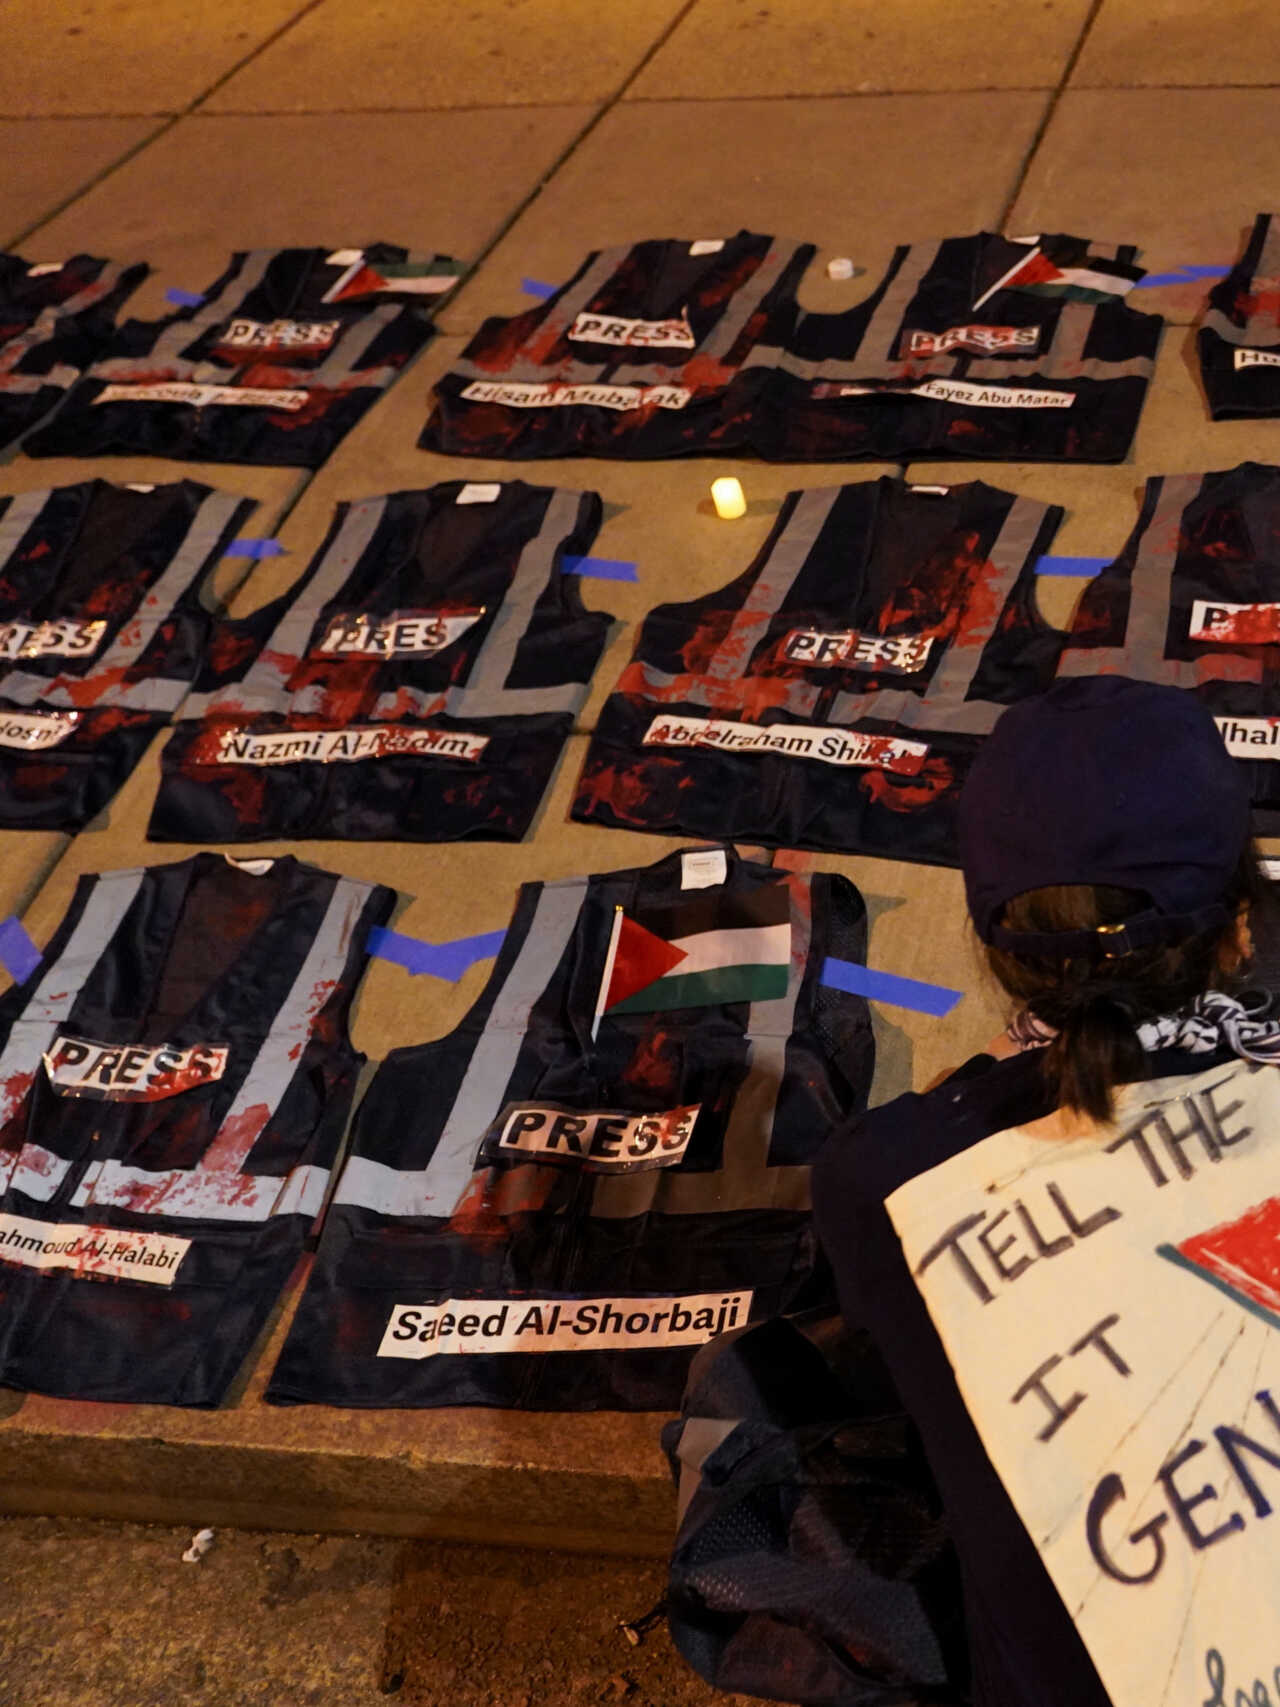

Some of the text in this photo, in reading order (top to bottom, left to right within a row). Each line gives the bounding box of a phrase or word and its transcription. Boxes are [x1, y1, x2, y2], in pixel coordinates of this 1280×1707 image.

[578, 320, 691, 341] PRESS
[914, 327, 1034, 348] PRESS
[563, 390, 681, 407] Mubaak
[925, 384, 1067, 406] Fayez Abu Matar
[787, 635, 927, 661] PRESS
[223, 735, 323, 758] Nazmi
[53, 1042, 214, 1085] PRESS
[506, 1111, 692, 1158] PRESS
[915, 1182, 1122, 1305] TELL
[1104, 1073, 1256, 1188] THE
[83, 1240, 178, 1270] Al-Halabi
[392, 1296, 741, 1342] Saeed Al-Shorbaji
[1012, 1313, 1133, 1443] IT
